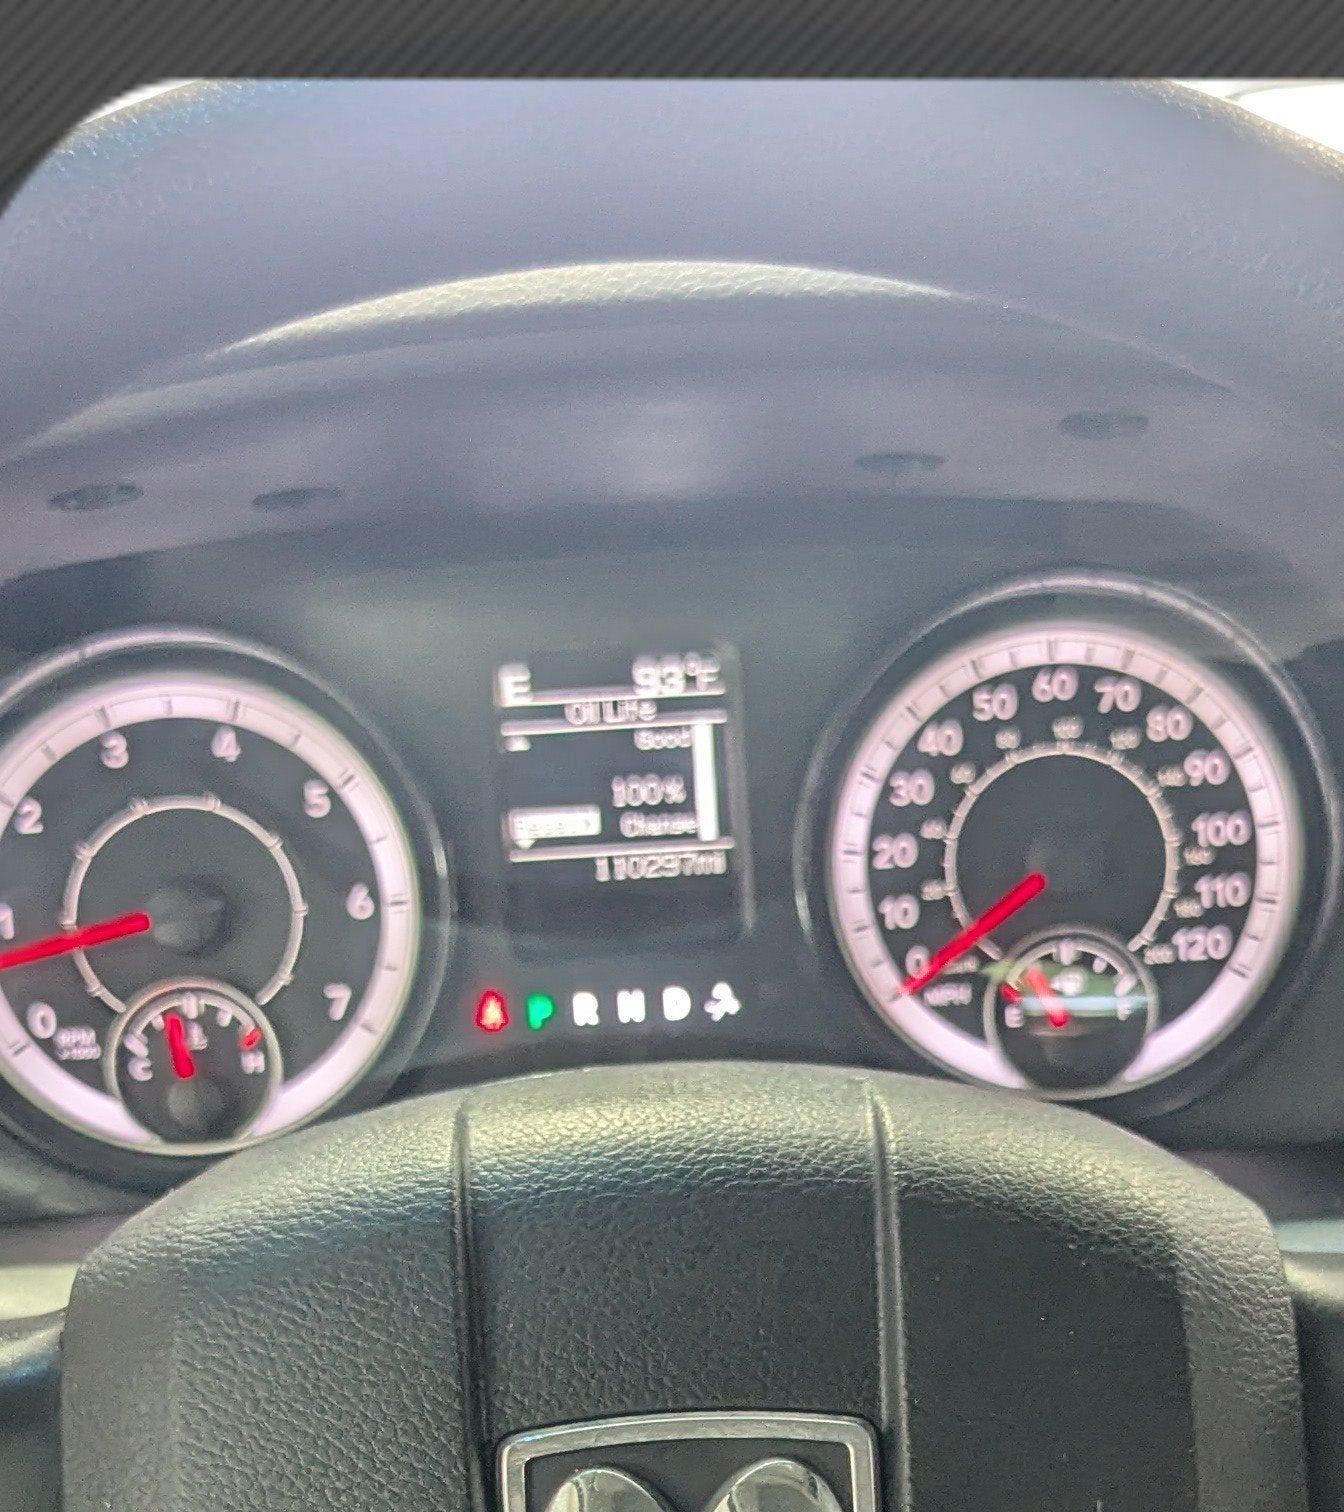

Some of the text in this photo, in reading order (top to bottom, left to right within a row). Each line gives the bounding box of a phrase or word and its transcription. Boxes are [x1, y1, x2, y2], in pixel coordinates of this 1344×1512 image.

[972, 683, 1019, 720] 50
[1030, 664, 1077, 702] 60
[1094, 673, 1142, 713] 70
[917, 719, 964, 757] 40
[1146, 704, 1192, 743] 80
[99, 729, 129, 769] 3
[211, 724, 241, 763] 4
[1183, 748, 1231, 786] 90
[302, 778, 331, 819] 5
[612, 773, 687, 808] 100%
[888, 767, 935, 806] 30
[15, 796, 44, 835] 2
[1190, 811, 1252, 848] 100
[872, 832, 919, 871] 20
[346, 882, 376, 921] 6
[1194, 872, 1252, 909] 110
[878, 893, 920, 930] 10
[1172, 924, 1233, 961] 120
[27, 1002, 56, 1039] 0
[322, 982, 353, 1022] 7
[527, 985, 692, 1029] P R N D
[127, 1056, 153, 1081] C
[241, 1050, 265, 1074] H
